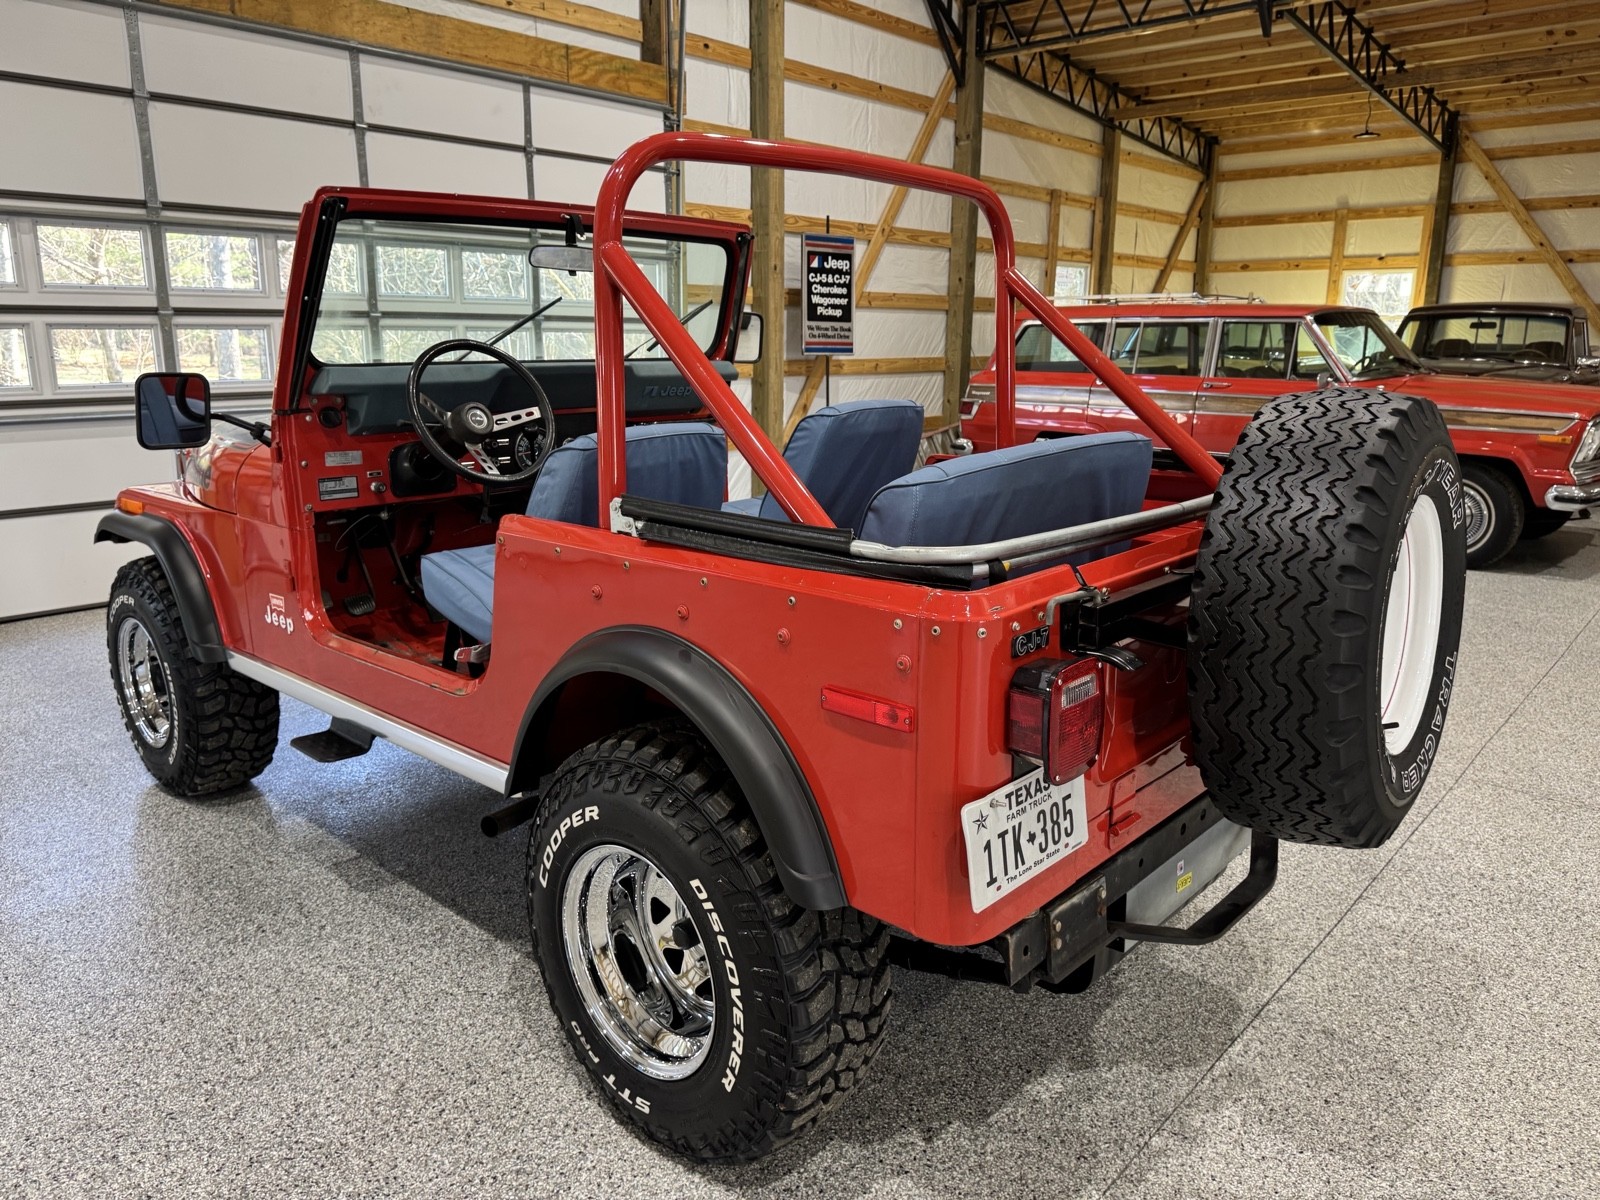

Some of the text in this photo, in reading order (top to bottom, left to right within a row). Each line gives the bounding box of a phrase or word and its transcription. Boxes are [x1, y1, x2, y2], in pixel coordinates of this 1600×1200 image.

[808, 273, 828, 283] CJ-5
[833, 275, 850, 284] CJ-7
[824, 256, 850, 272] Jeep
[811, 294, 848, 306] Wagoneer
[812, 284, 848, 295] Cherokee
[817, 306, 842, 318] Pickup
[661, 385, 692, 397] Jeep
[110, 595, 135, 623] COOPER
[265, 605, 294, 635] Jeep
[1016, 626, 1049, 656] CJ-7
[1401, 651, 1457, 792] TRACKER
[1006, 791, 1053, 823] FARM TRUCK
[539, 805, 600, 889] COOPER
[1006, 848, 1061, 884] The Lone Star State
[689, 878, 744, 1093] DISCOVERER
[603, 1073, 651, 1114] STT
